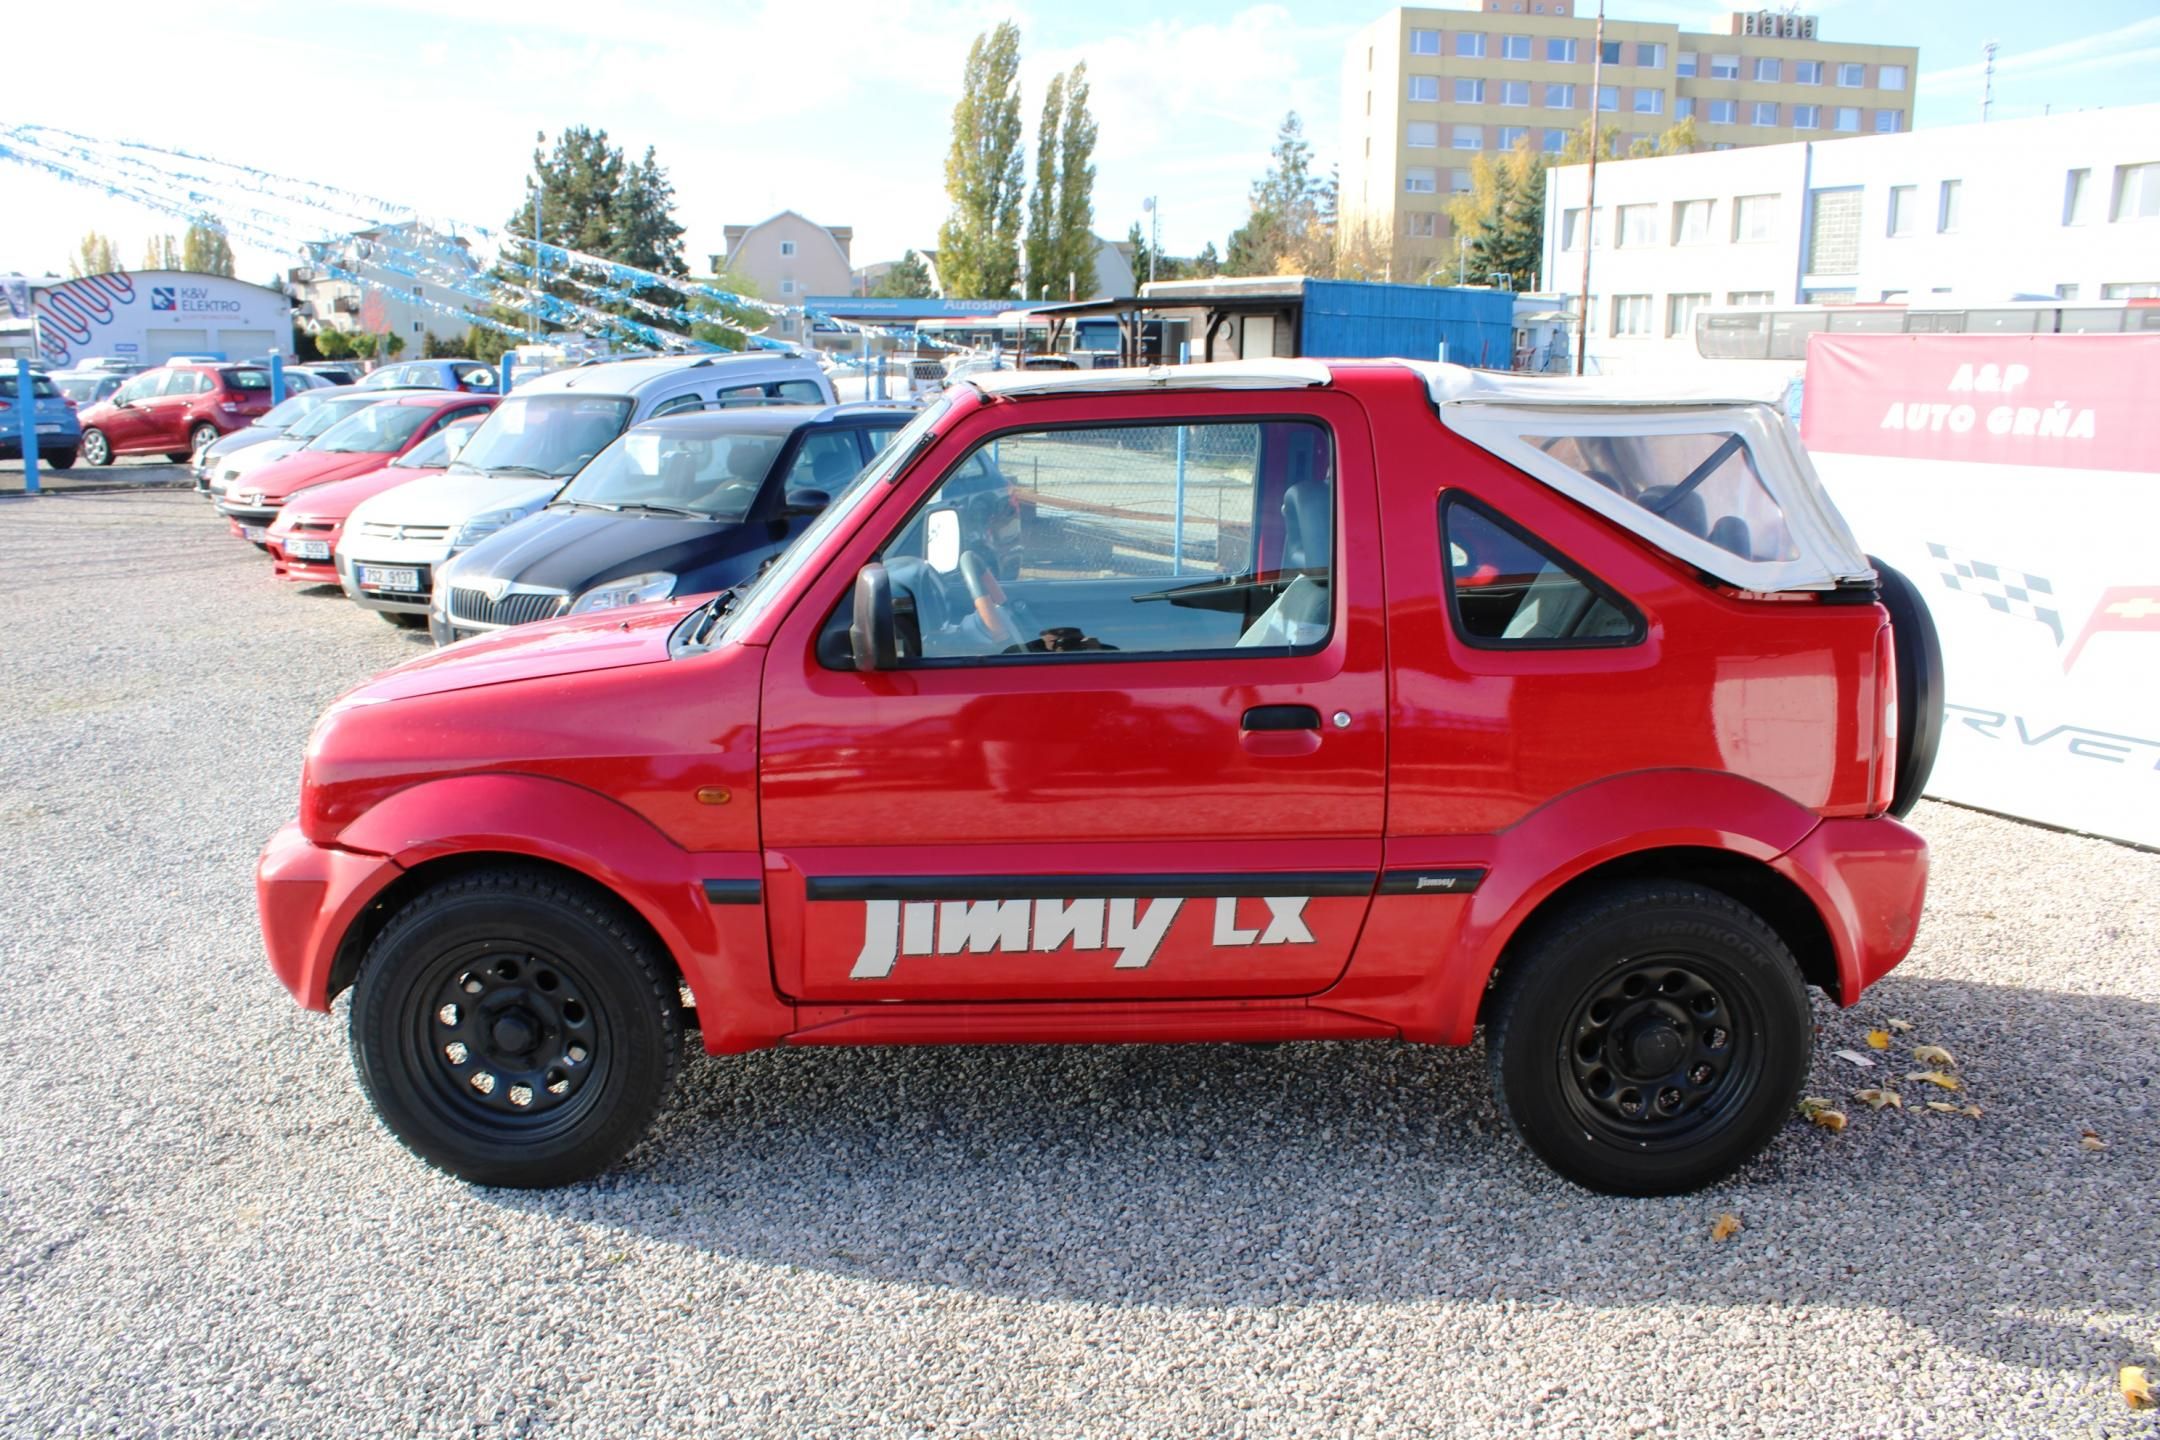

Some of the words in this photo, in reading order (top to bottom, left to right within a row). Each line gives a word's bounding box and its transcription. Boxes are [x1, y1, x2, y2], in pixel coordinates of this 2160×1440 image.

[180, 287, 209, 299] K&V
[181, 300, 241, 312] ELEKTRO
[1947, 363, 2030, 392] A&P
[1880, 402, 1977, 432] AUTO
[1986, 400, 2096, 438] GRŇA
[1944, 702, 2160, 770] RVE
[1212, 896, 1317, 947] LX
